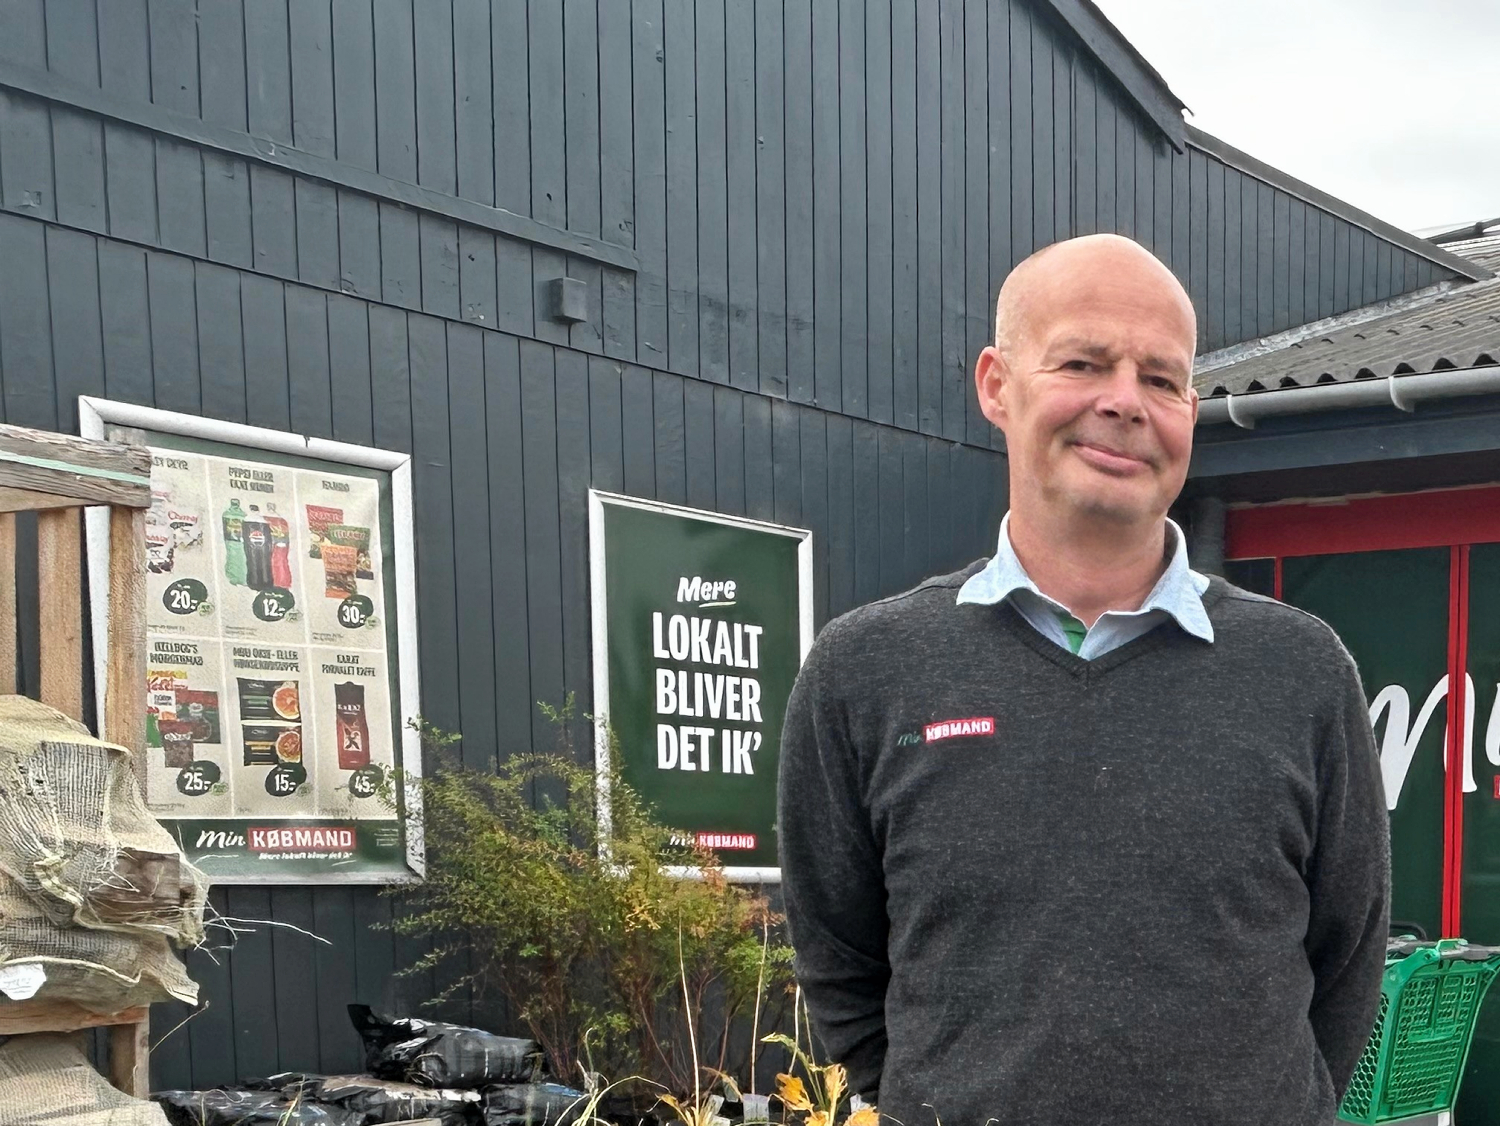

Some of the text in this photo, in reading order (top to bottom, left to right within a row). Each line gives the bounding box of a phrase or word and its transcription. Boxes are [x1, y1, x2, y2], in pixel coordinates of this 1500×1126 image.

[677, 576, 737, 603] Mere
[652, 611, 763, 669] LOKALT
[656, 668, 763, 722] BLIVER
[656, 723, 762, 776] DET IK'
[196, 830, 246, 849] Min
[252, 829, 353, 849] KØBMAND
